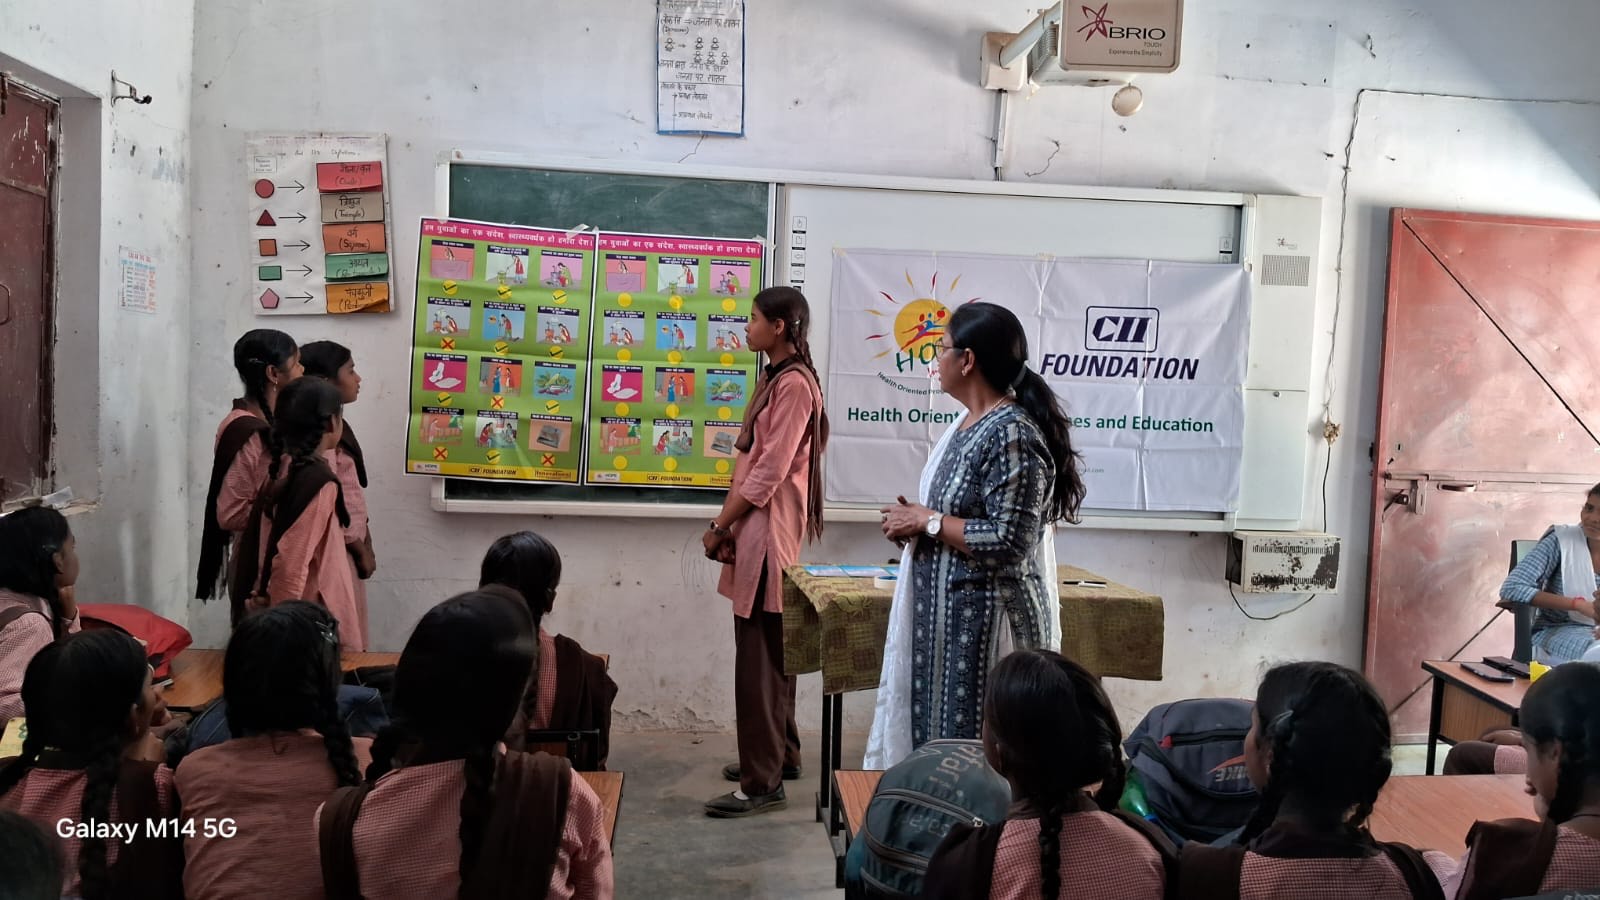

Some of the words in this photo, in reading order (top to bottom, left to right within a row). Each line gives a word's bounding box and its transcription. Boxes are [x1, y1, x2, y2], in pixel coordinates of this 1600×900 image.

[461, 227, 470, 235] का
[472, 228, 483, 237] एक
[633, 240, 642, 248] का
[644, 241, 654, 249] एक
[1092, 316, 1152, 343] CII
[896, 342, 938, 373] HO
[1040, 354, 1200, 381] FOUNDATION
[877, 371, 898, 389] Health
[897, 384, 927, 396] Oriented
[848, 407, 903, 422] Health
[908, 408, 960, 424] Orient
[1096, 415, 1127, 429] and
[1132, 415, 1214, 433] Education
